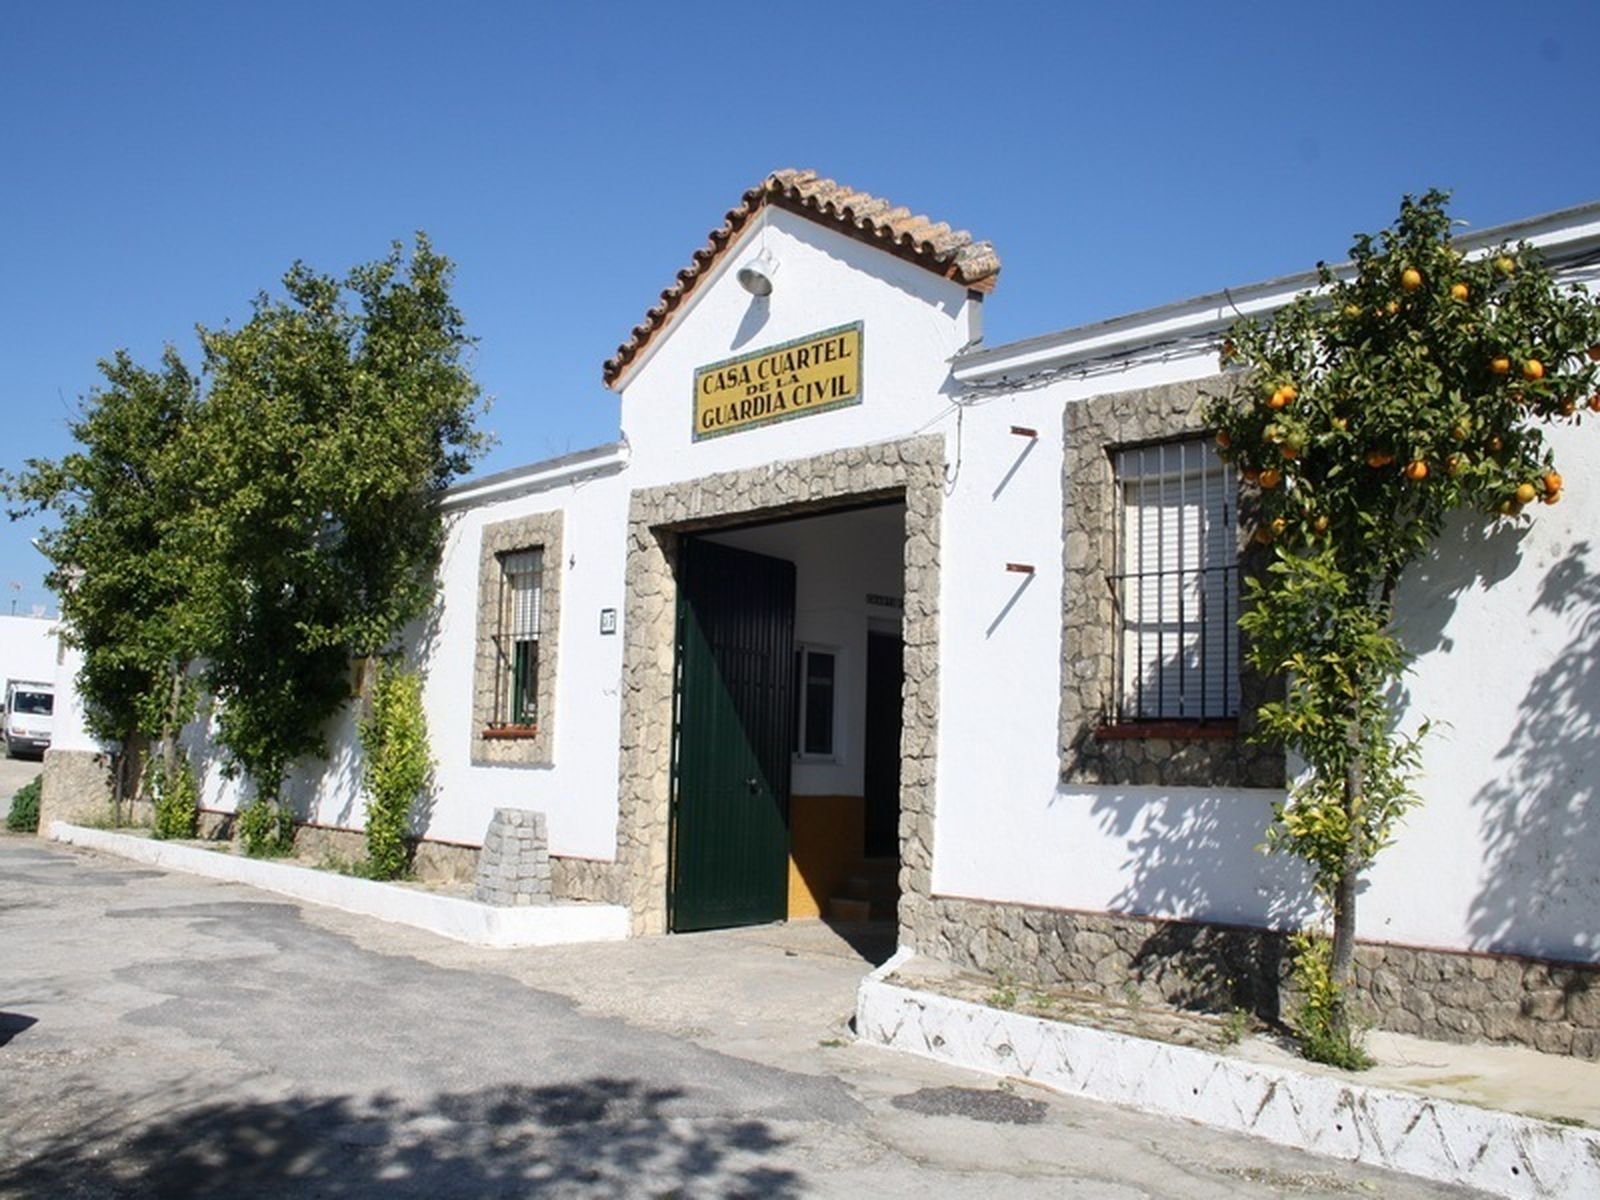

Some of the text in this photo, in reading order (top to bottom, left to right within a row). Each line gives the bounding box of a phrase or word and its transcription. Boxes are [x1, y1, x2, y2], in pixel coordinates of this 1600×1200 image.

[703, 338, 852, 394] CASA CUARTEL
[746, 374, 799, 395] DE LA
[702, 375, 852, 428] GUARDIA CIVIL
